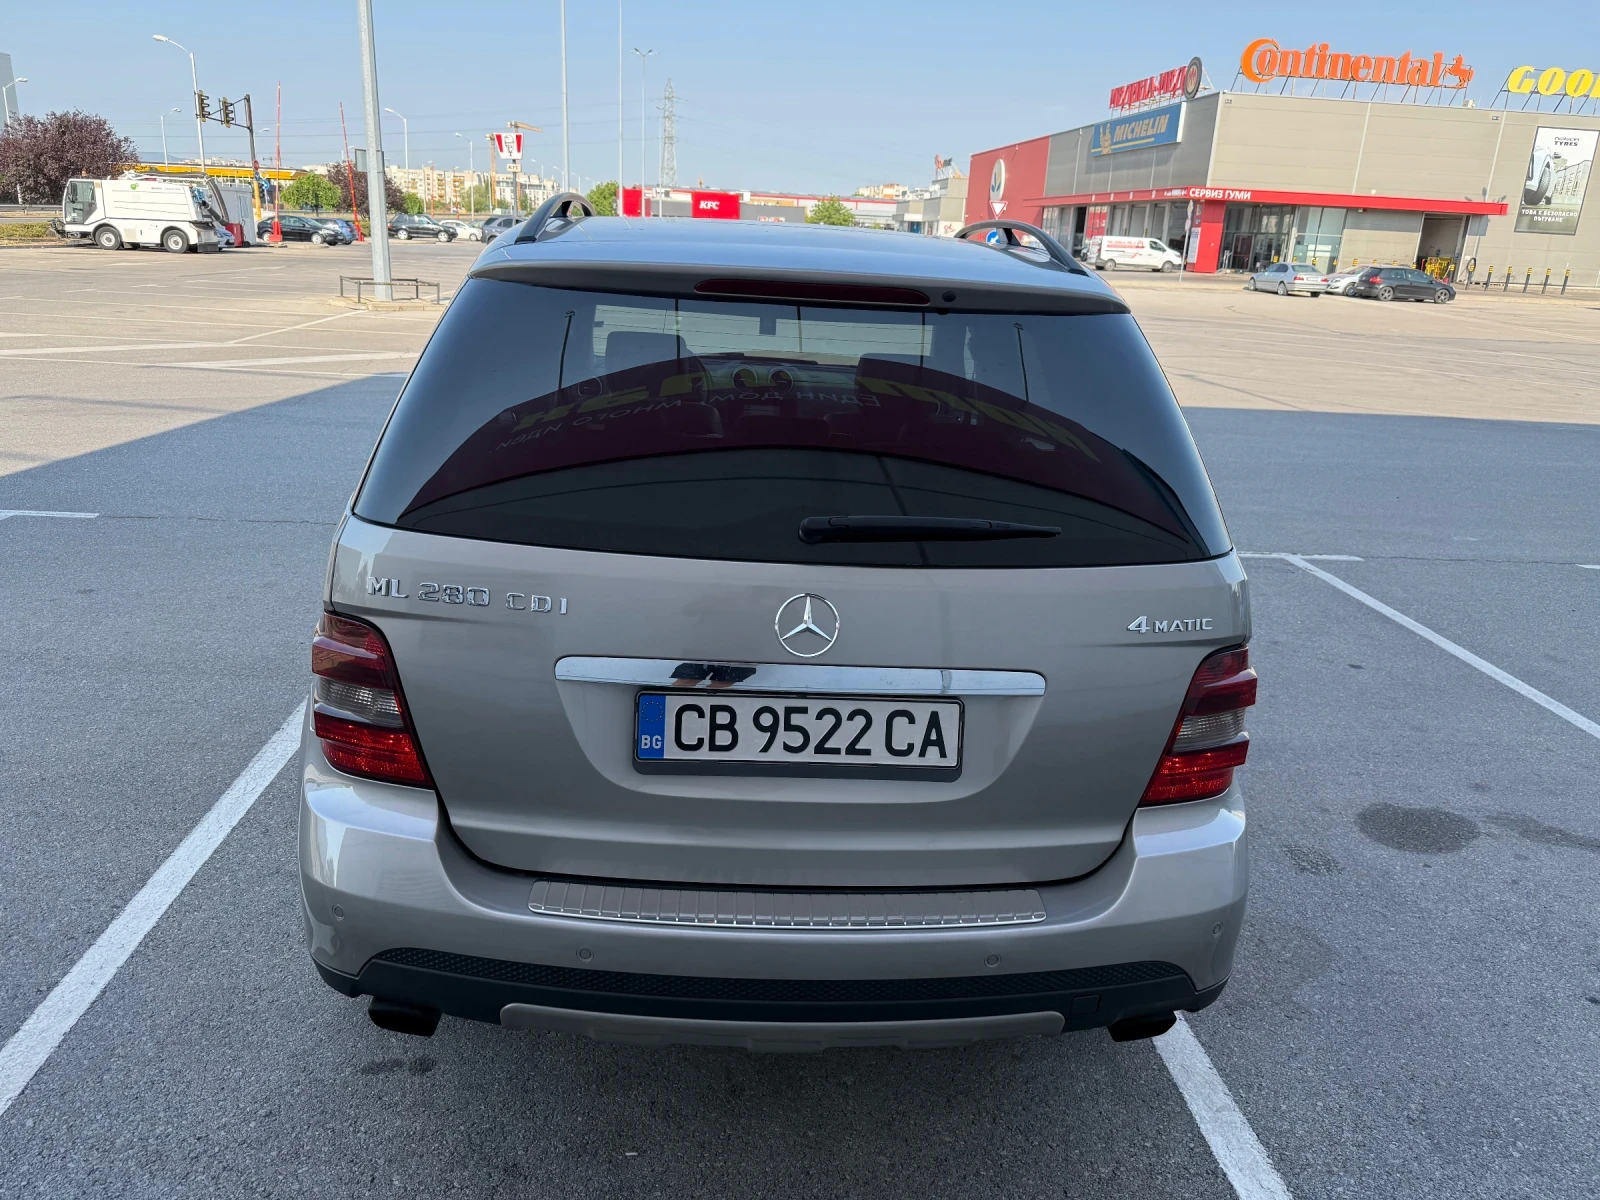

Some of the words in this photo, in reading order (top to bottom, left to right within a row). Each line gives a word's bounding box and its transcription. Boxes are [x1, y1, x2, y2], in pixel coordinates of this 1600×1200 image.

[1241, 38, 1444, 87] Continental
[1114, 114, 1170, 142] MICHELIN
[699, 200, 719, 210] KFC
[1189, 187, 1223, 198] СЕРВИЗ
[1225, 190, 1251, 200] ГУМИ
[368, 576, 409, 598] ML
[417, 582, 490, 607] 280
[505, 592, 568, 614] CDI
[641, 735, 662, 749] BG
[674, 703, 739, 752] CB
[752, 705, 873, 756] 9522
[885, 709, 948, 758] CA
